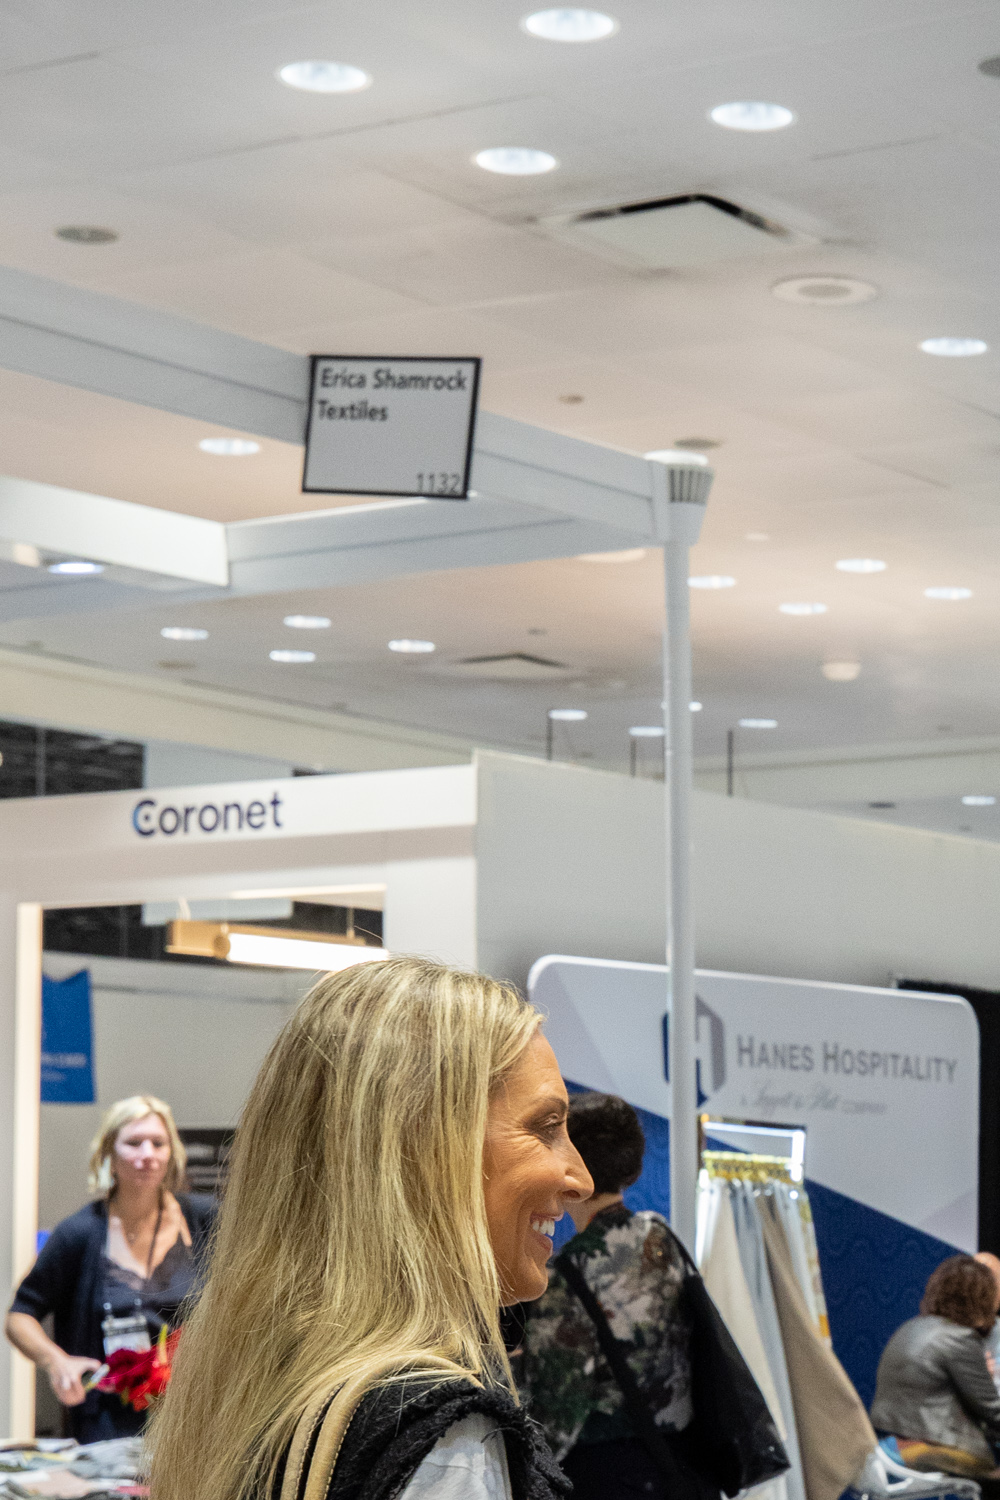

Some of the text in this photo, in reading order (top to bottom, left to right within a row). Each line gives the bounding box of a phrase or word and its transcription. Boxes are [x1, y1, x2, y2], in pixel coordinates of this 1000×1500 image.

[320, 367, 467, 391] Erica Shamrock
[318, 400, 388, 421] Textiles
[417, 472, 461, 494] 1132
[132, 791, 283, 837] Coronet
[736, 1034, 958, 1084] HANES HOSPITALITY
